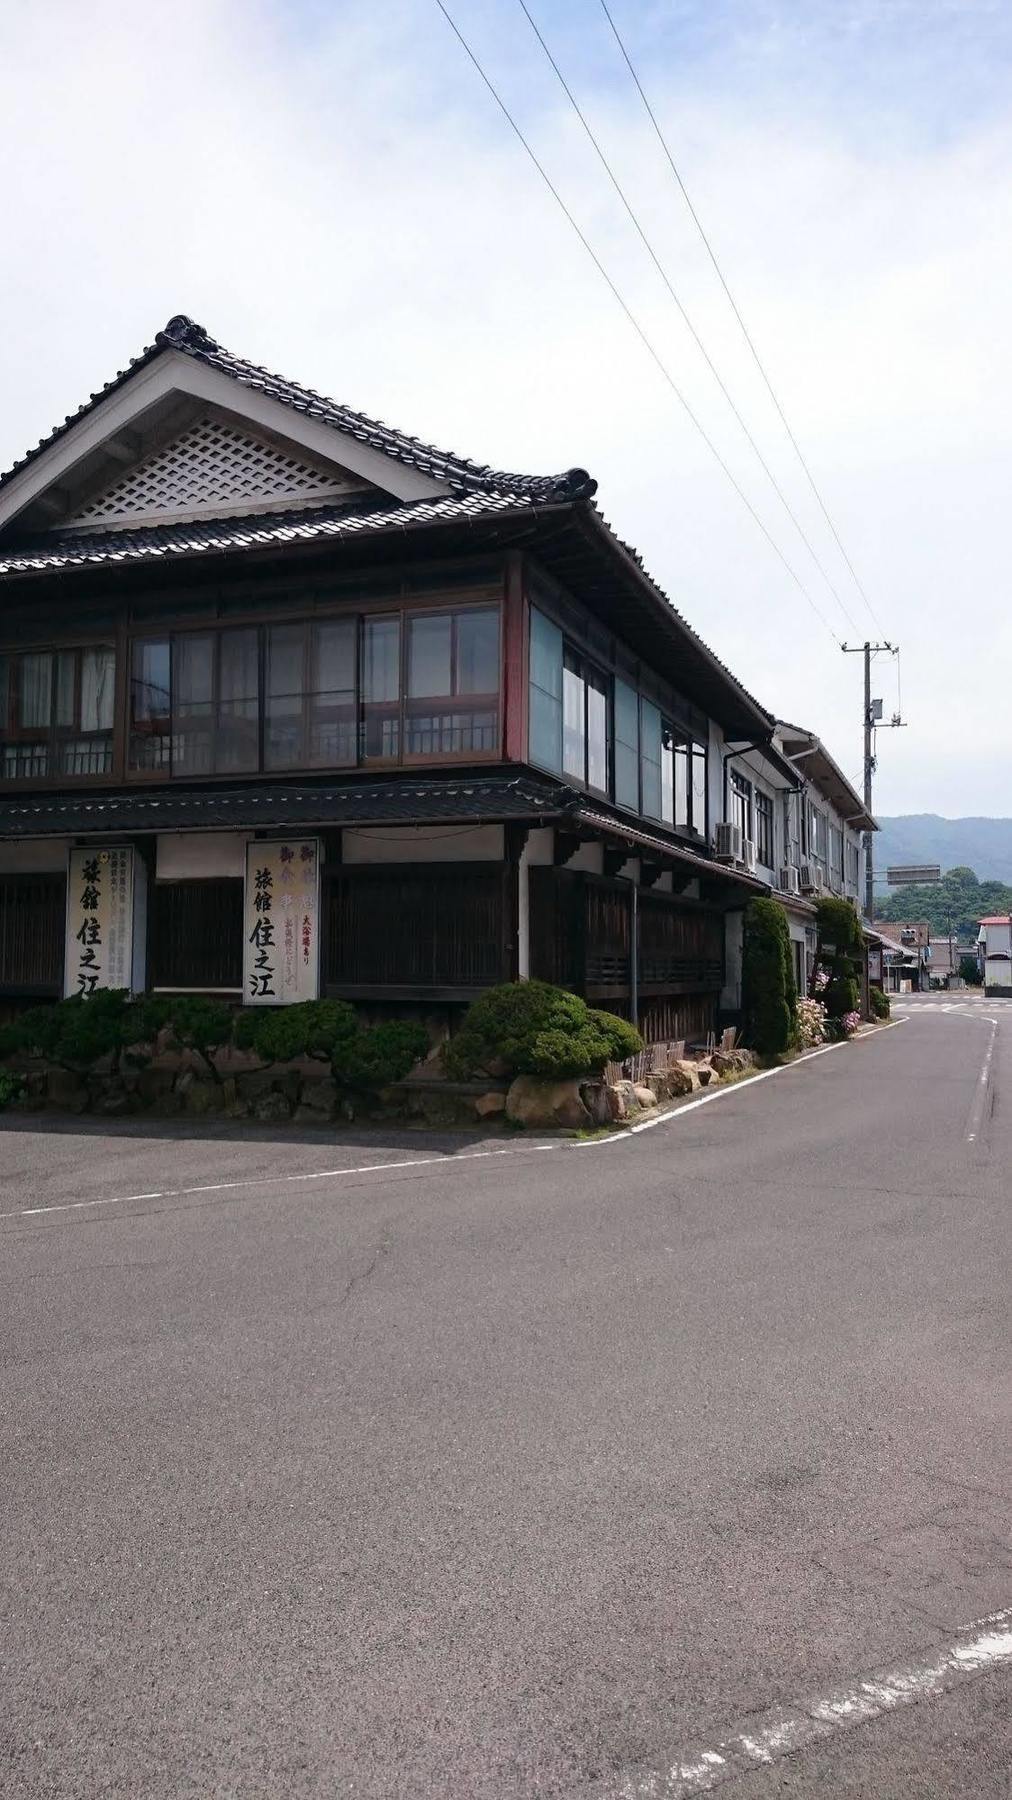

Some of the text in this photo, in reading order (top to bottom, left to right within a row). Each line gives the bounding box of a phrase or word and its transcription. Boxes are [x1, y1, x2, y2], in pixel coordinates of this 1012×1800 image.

[302, 915, 312, 965] 大浴場あり
